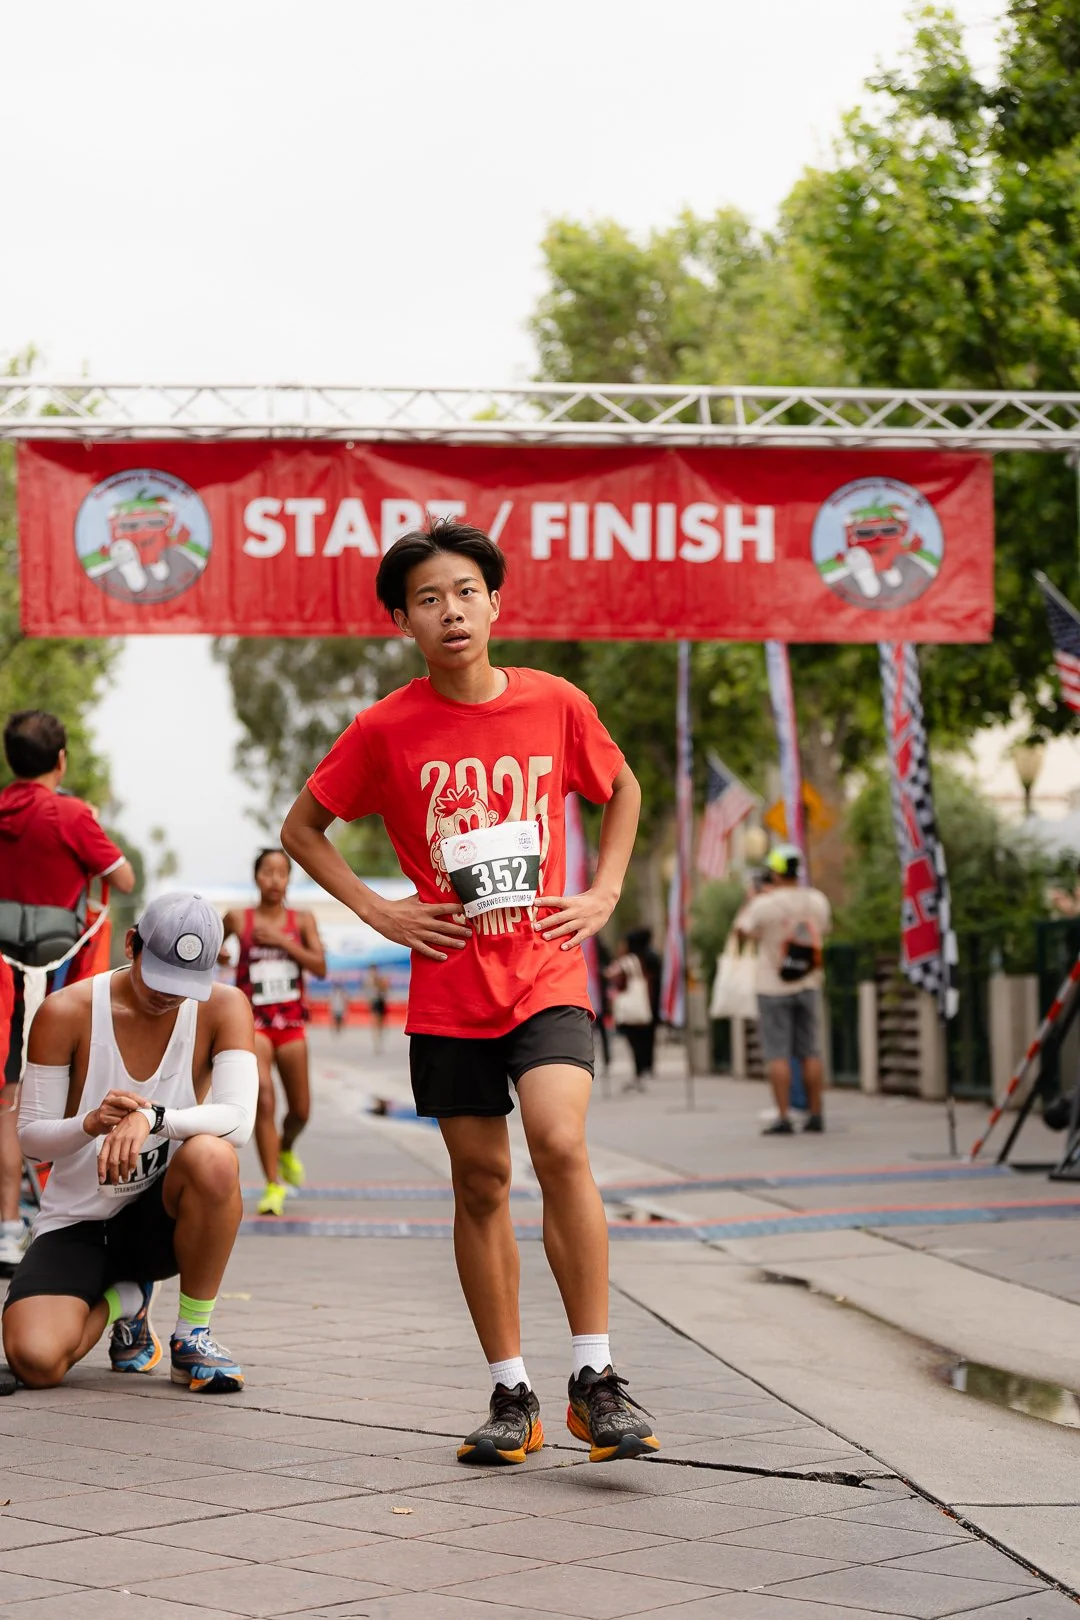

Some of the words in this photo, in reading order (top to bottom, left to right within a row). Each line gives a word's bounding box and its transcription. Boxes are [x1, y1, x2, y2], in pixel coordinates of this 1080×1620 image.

[531, 501, 775, 563] FINISH
[471, 857, 530, 897] 352
[476, 896, 511, 911] STRAWBERRY
[118, 1149, 160, 1184] 12
